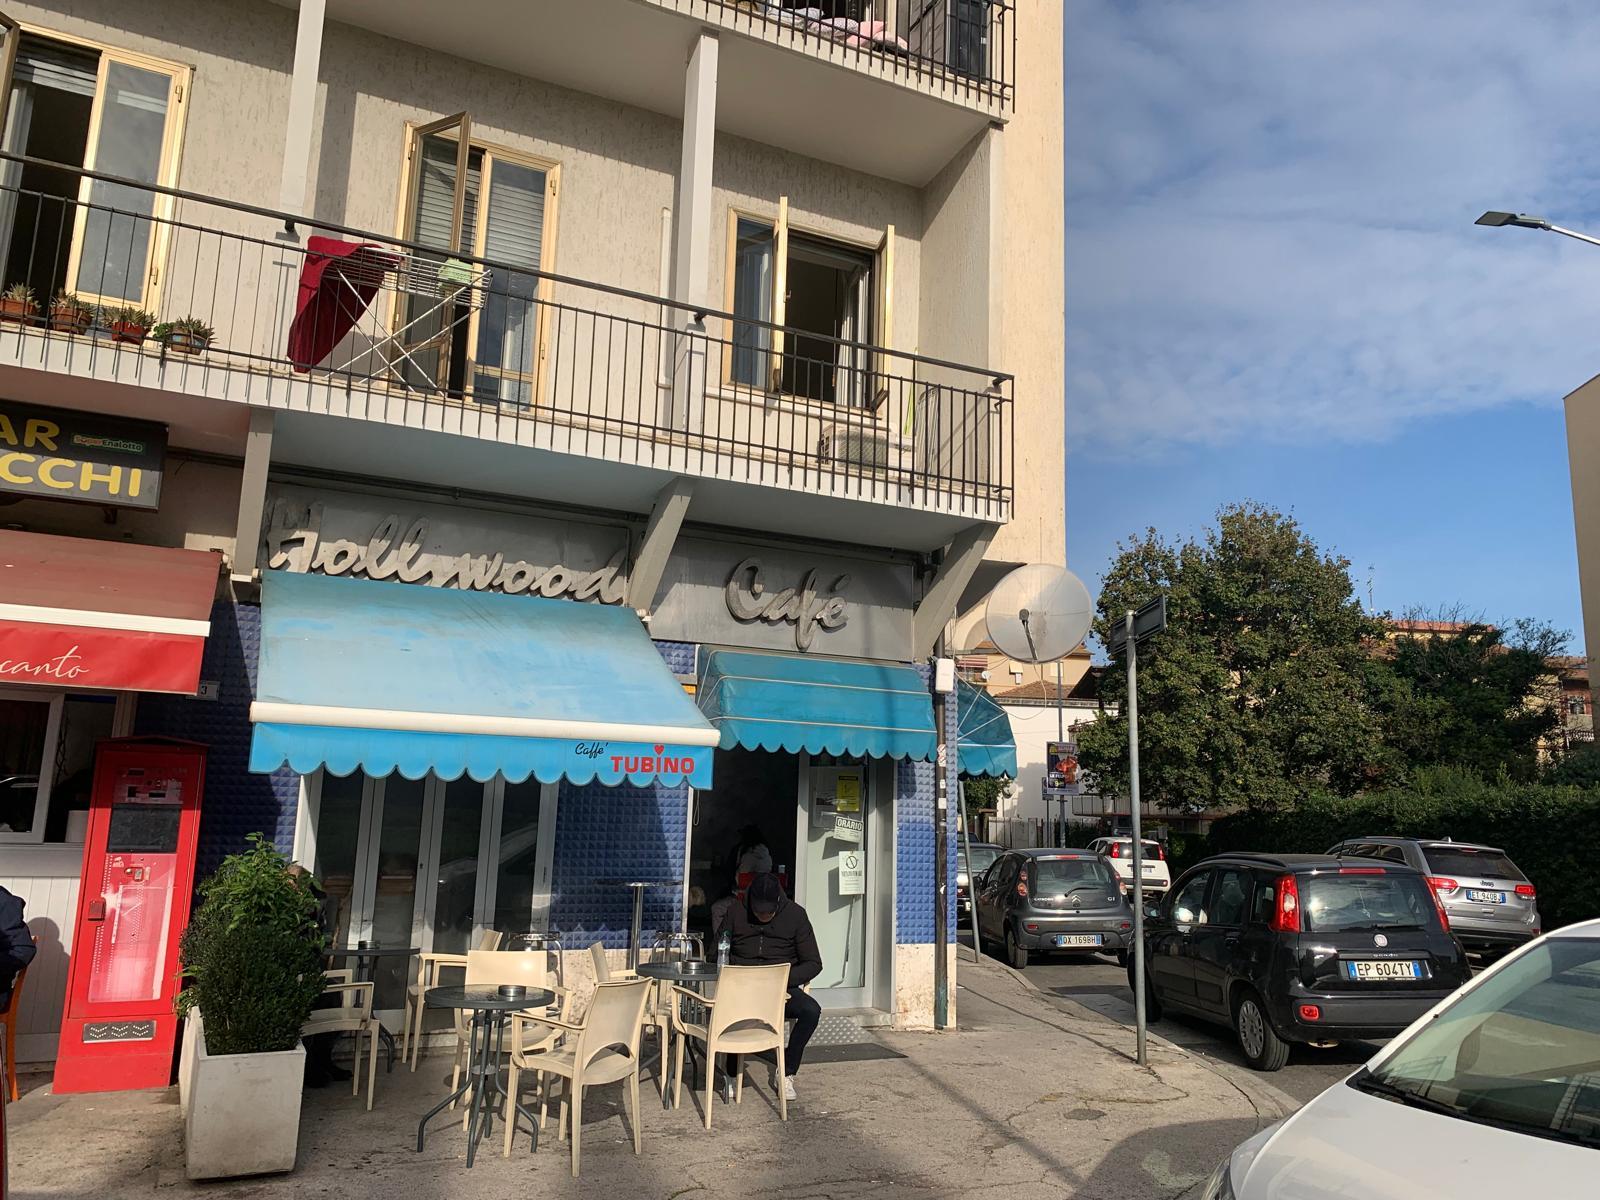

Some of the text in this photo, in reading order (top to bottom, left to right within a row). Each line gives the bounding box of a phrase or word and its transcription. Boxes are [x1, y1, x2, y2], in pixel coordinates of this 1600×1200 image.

[725, 557, 849, 651] Café
[837, 818, 862, 830] ORARIO
[1357, 963, 1412, 976] EP 604TY
